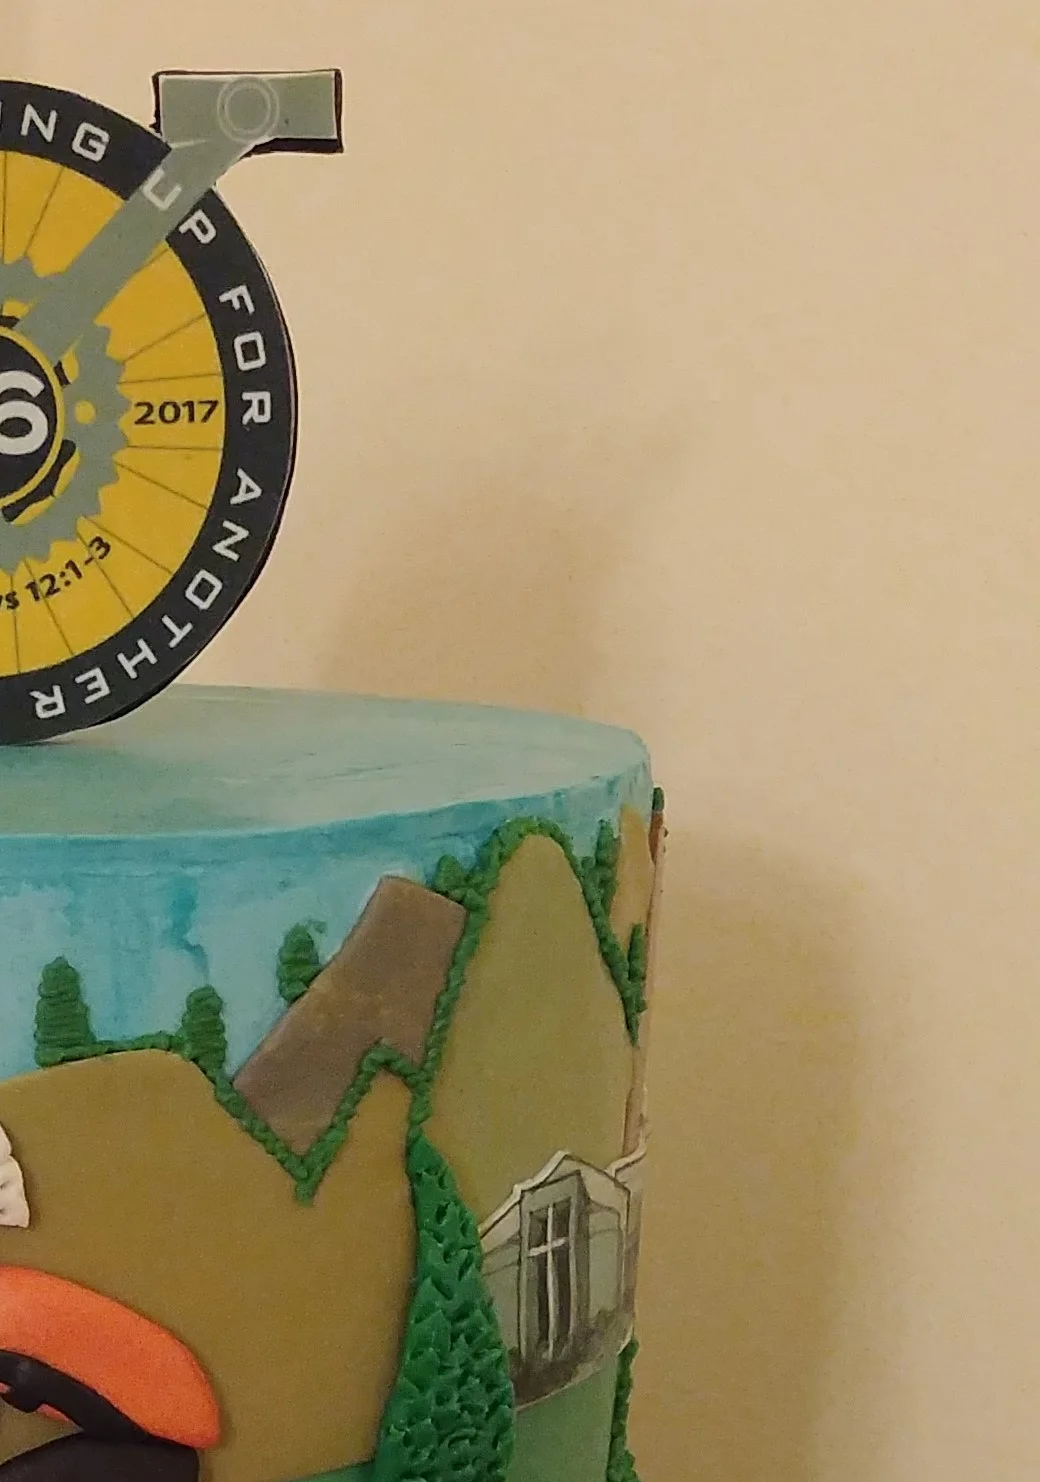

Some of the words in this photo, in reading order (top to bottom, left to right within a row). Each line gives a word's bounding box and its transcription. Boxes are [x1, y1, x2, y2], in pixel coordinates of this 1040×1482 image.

[218, 284, 272, 425] FOR
[134, 399, 220, 425] 2017
[25, 535, 111, 602] 12:1-3
[28, 468, 262, 720] ANOTHER
